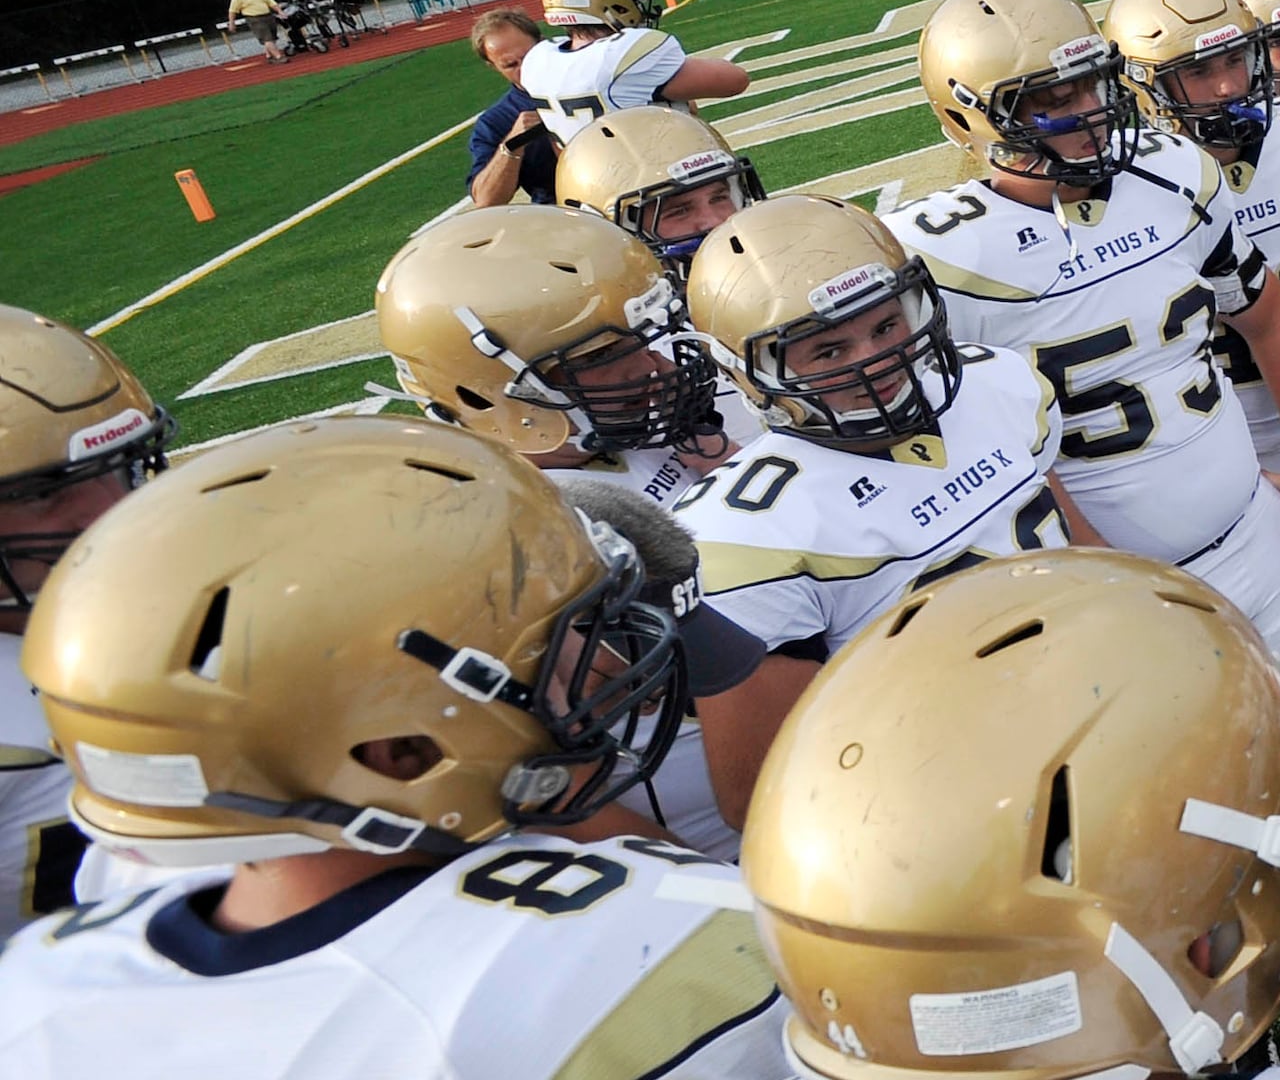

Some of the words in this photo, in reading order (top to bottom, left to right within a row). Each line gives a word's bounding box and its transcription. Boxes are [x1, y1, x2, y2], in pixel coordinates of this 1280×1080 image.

[1201, 27, 1239, 48] Riddell
[681, 153, 715, 171] Riddell
[1234, 198, 1278, 227] PIUS
[1058, 252, 1094, 280] ST.
[1095, 232, 1143, 264] PIUS
[1146, 225, 1161, 244] X
[825, 270, 870, 298] Riddell
[1029, 280, 1223, 463] 53
[643, 463, 682, 502] PIUS
[911, 495, 949, 528] ST.
[943, 457, 997, 504] PIUS
[996, 448, 1013, 468] X
